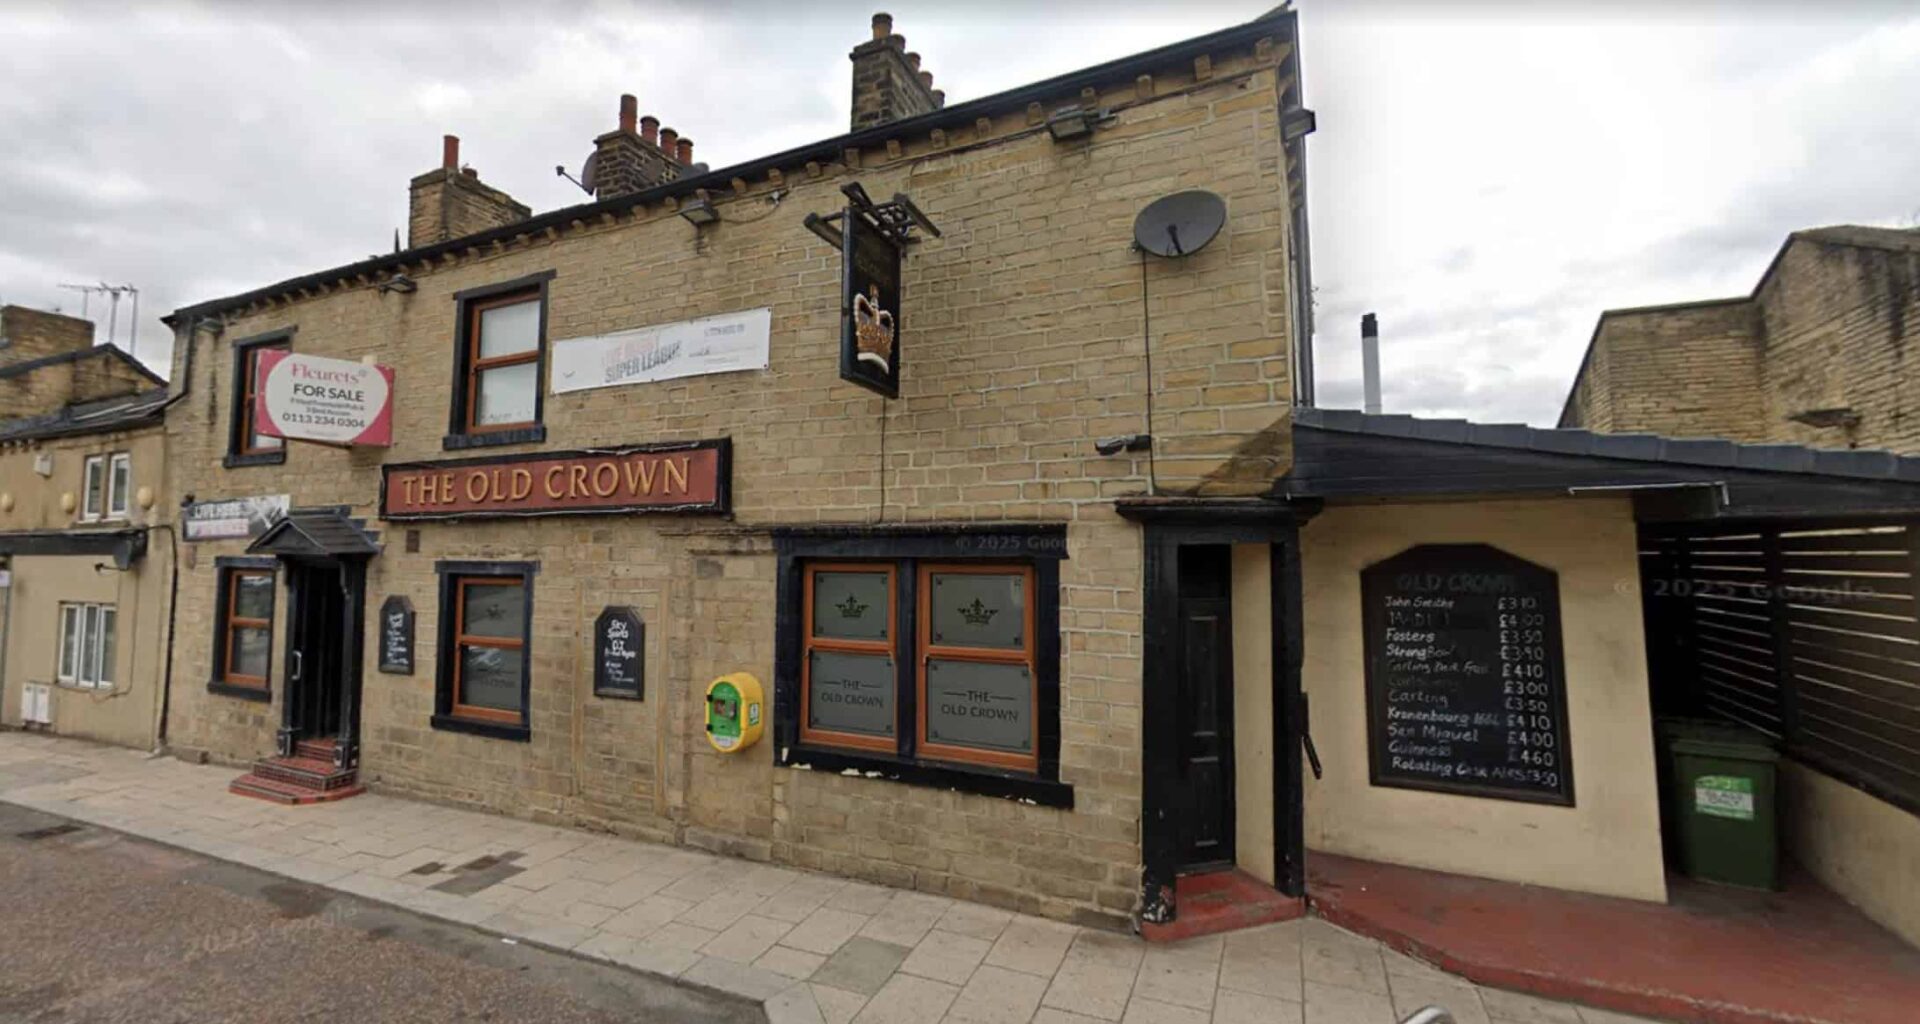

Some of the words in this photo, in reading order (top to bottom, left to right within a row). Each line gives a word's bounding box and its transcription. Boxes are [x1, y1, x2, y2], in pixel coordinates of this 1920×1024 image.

[291, 362, 360, 384] Fleurets
[604, 358, 639, 383] SUPER
[293, 383, 325, 399] FOR
[328, 387, 365, 403] SALE
[282, 412, 312, 424] 0113
[314, 415, 335, 425] 234
[337, 417, 365, 428] 0304
[403, 475, 457, 506] THE
[466, 469, 533, 502] OLD
[544, 456, 692, 499] CROWN
[1384, 596, 1410, 608] John
[610, 619, 628, 630] Sky
[1385, 628, 1436, 644] Fosters
[841, 678, 861, 691] THE
[820, 691, 843, 704] OLD
[844, 693, 884, 709] CROWN
[966, 689, 991, 703] THE
[941, 703, 967, 717] OLD
[970, 704, 1019, 722] CROWN
[1387, 707, 1469, 727] Kronenbourg
[1387, 725, 1416, 737] San
[1422, 725, 1479, 743] Miguel
[1391, 757, 1452, 777] Rotating
